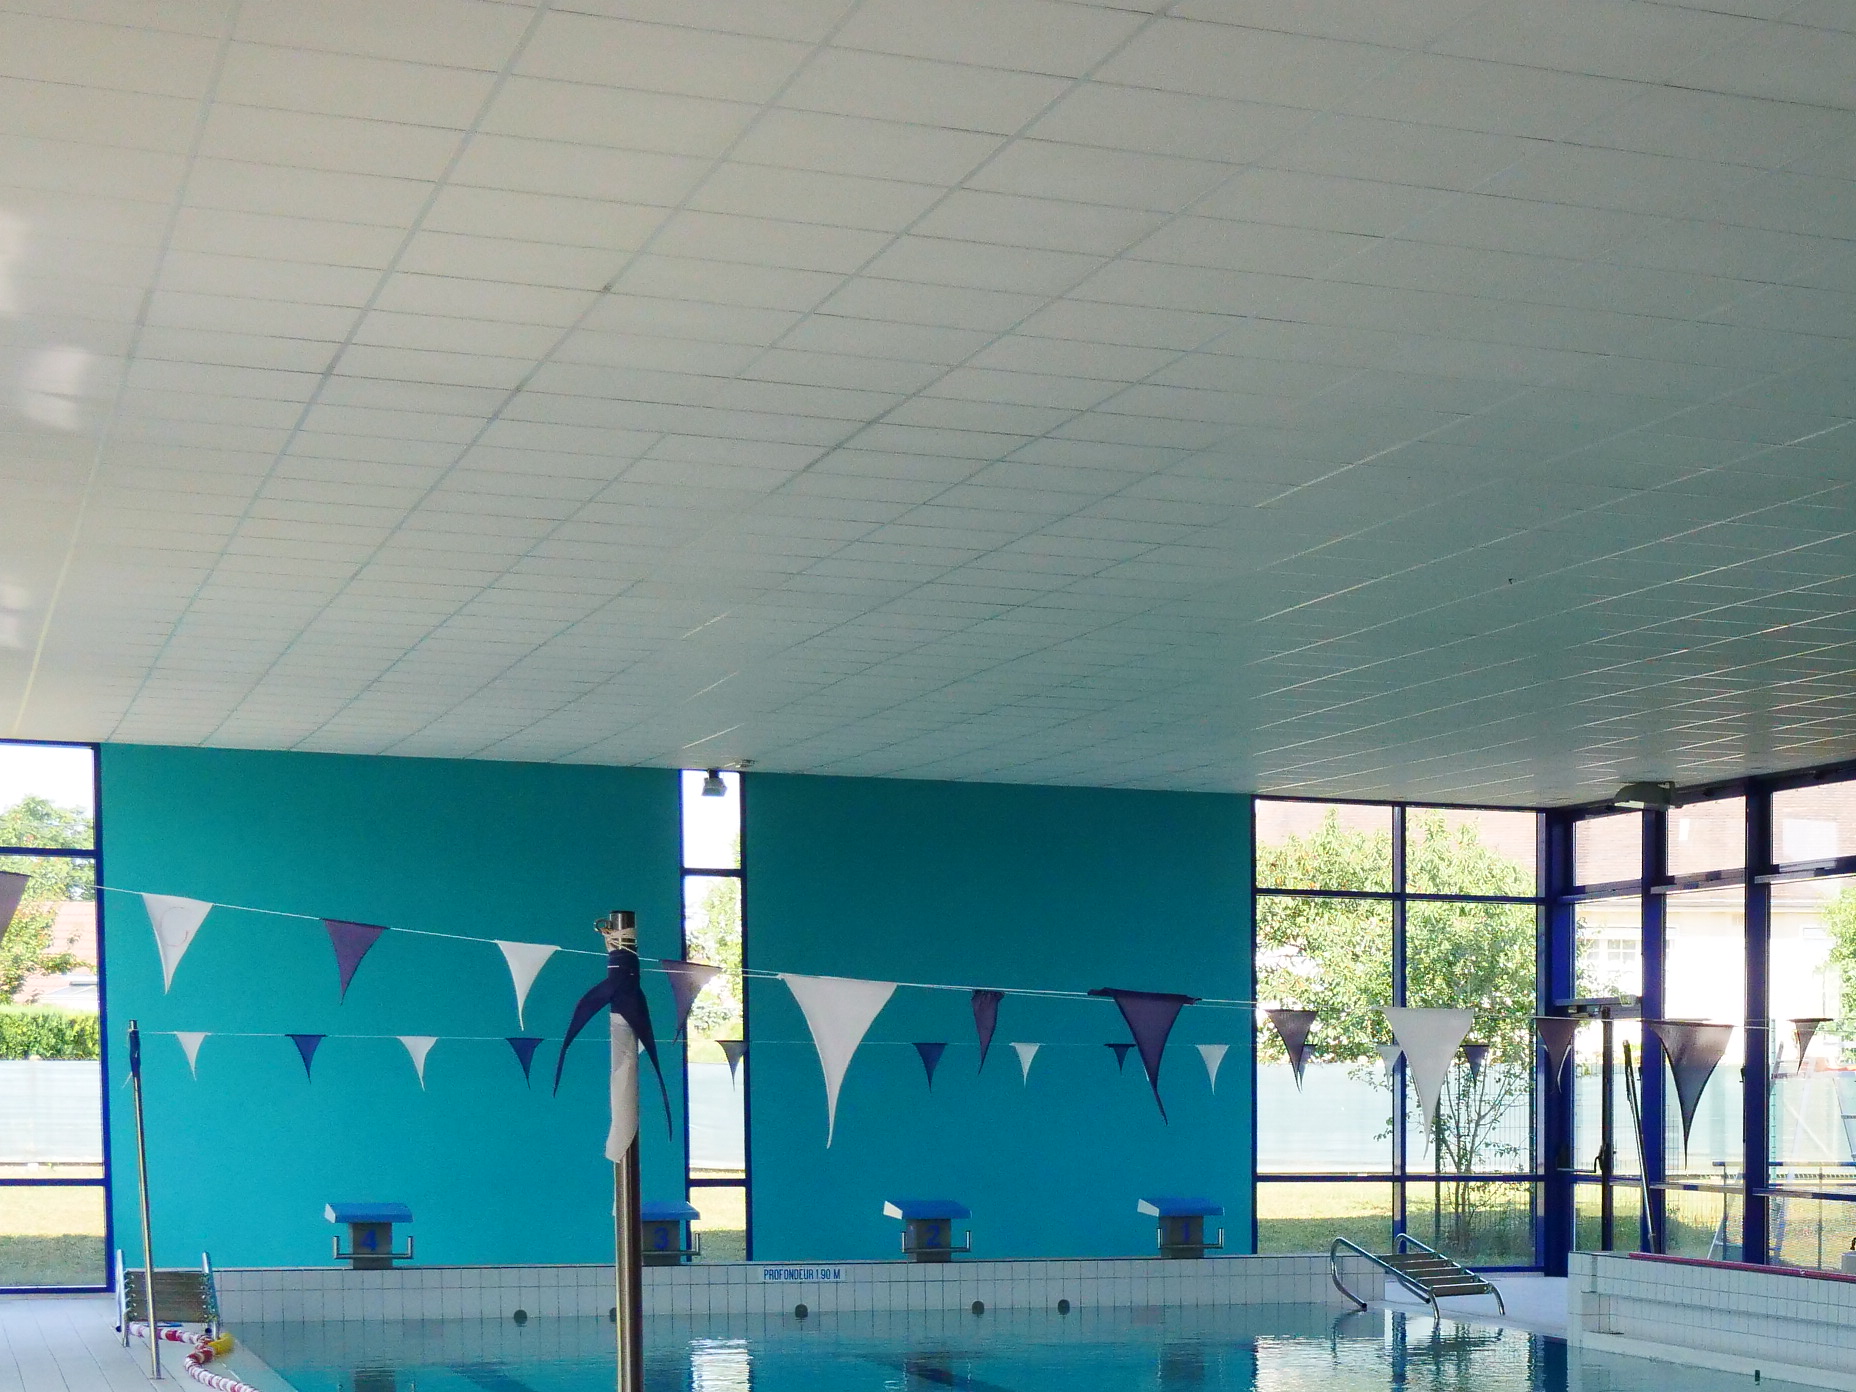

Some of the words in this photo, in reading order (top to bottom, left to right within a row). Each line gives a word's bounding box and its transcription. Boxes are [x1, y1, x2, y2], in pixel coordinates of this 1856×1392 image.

[360, 1230, 376, 1252] 4
[654, 1227, 670, 1250] 3
[926, 1225, 941, 1247] 2
[1181, 1222, 1190, 1243] 1
[763, 1268, 814, 1280] PROFONDEUR
[833, 1268, 841, 1280] M
